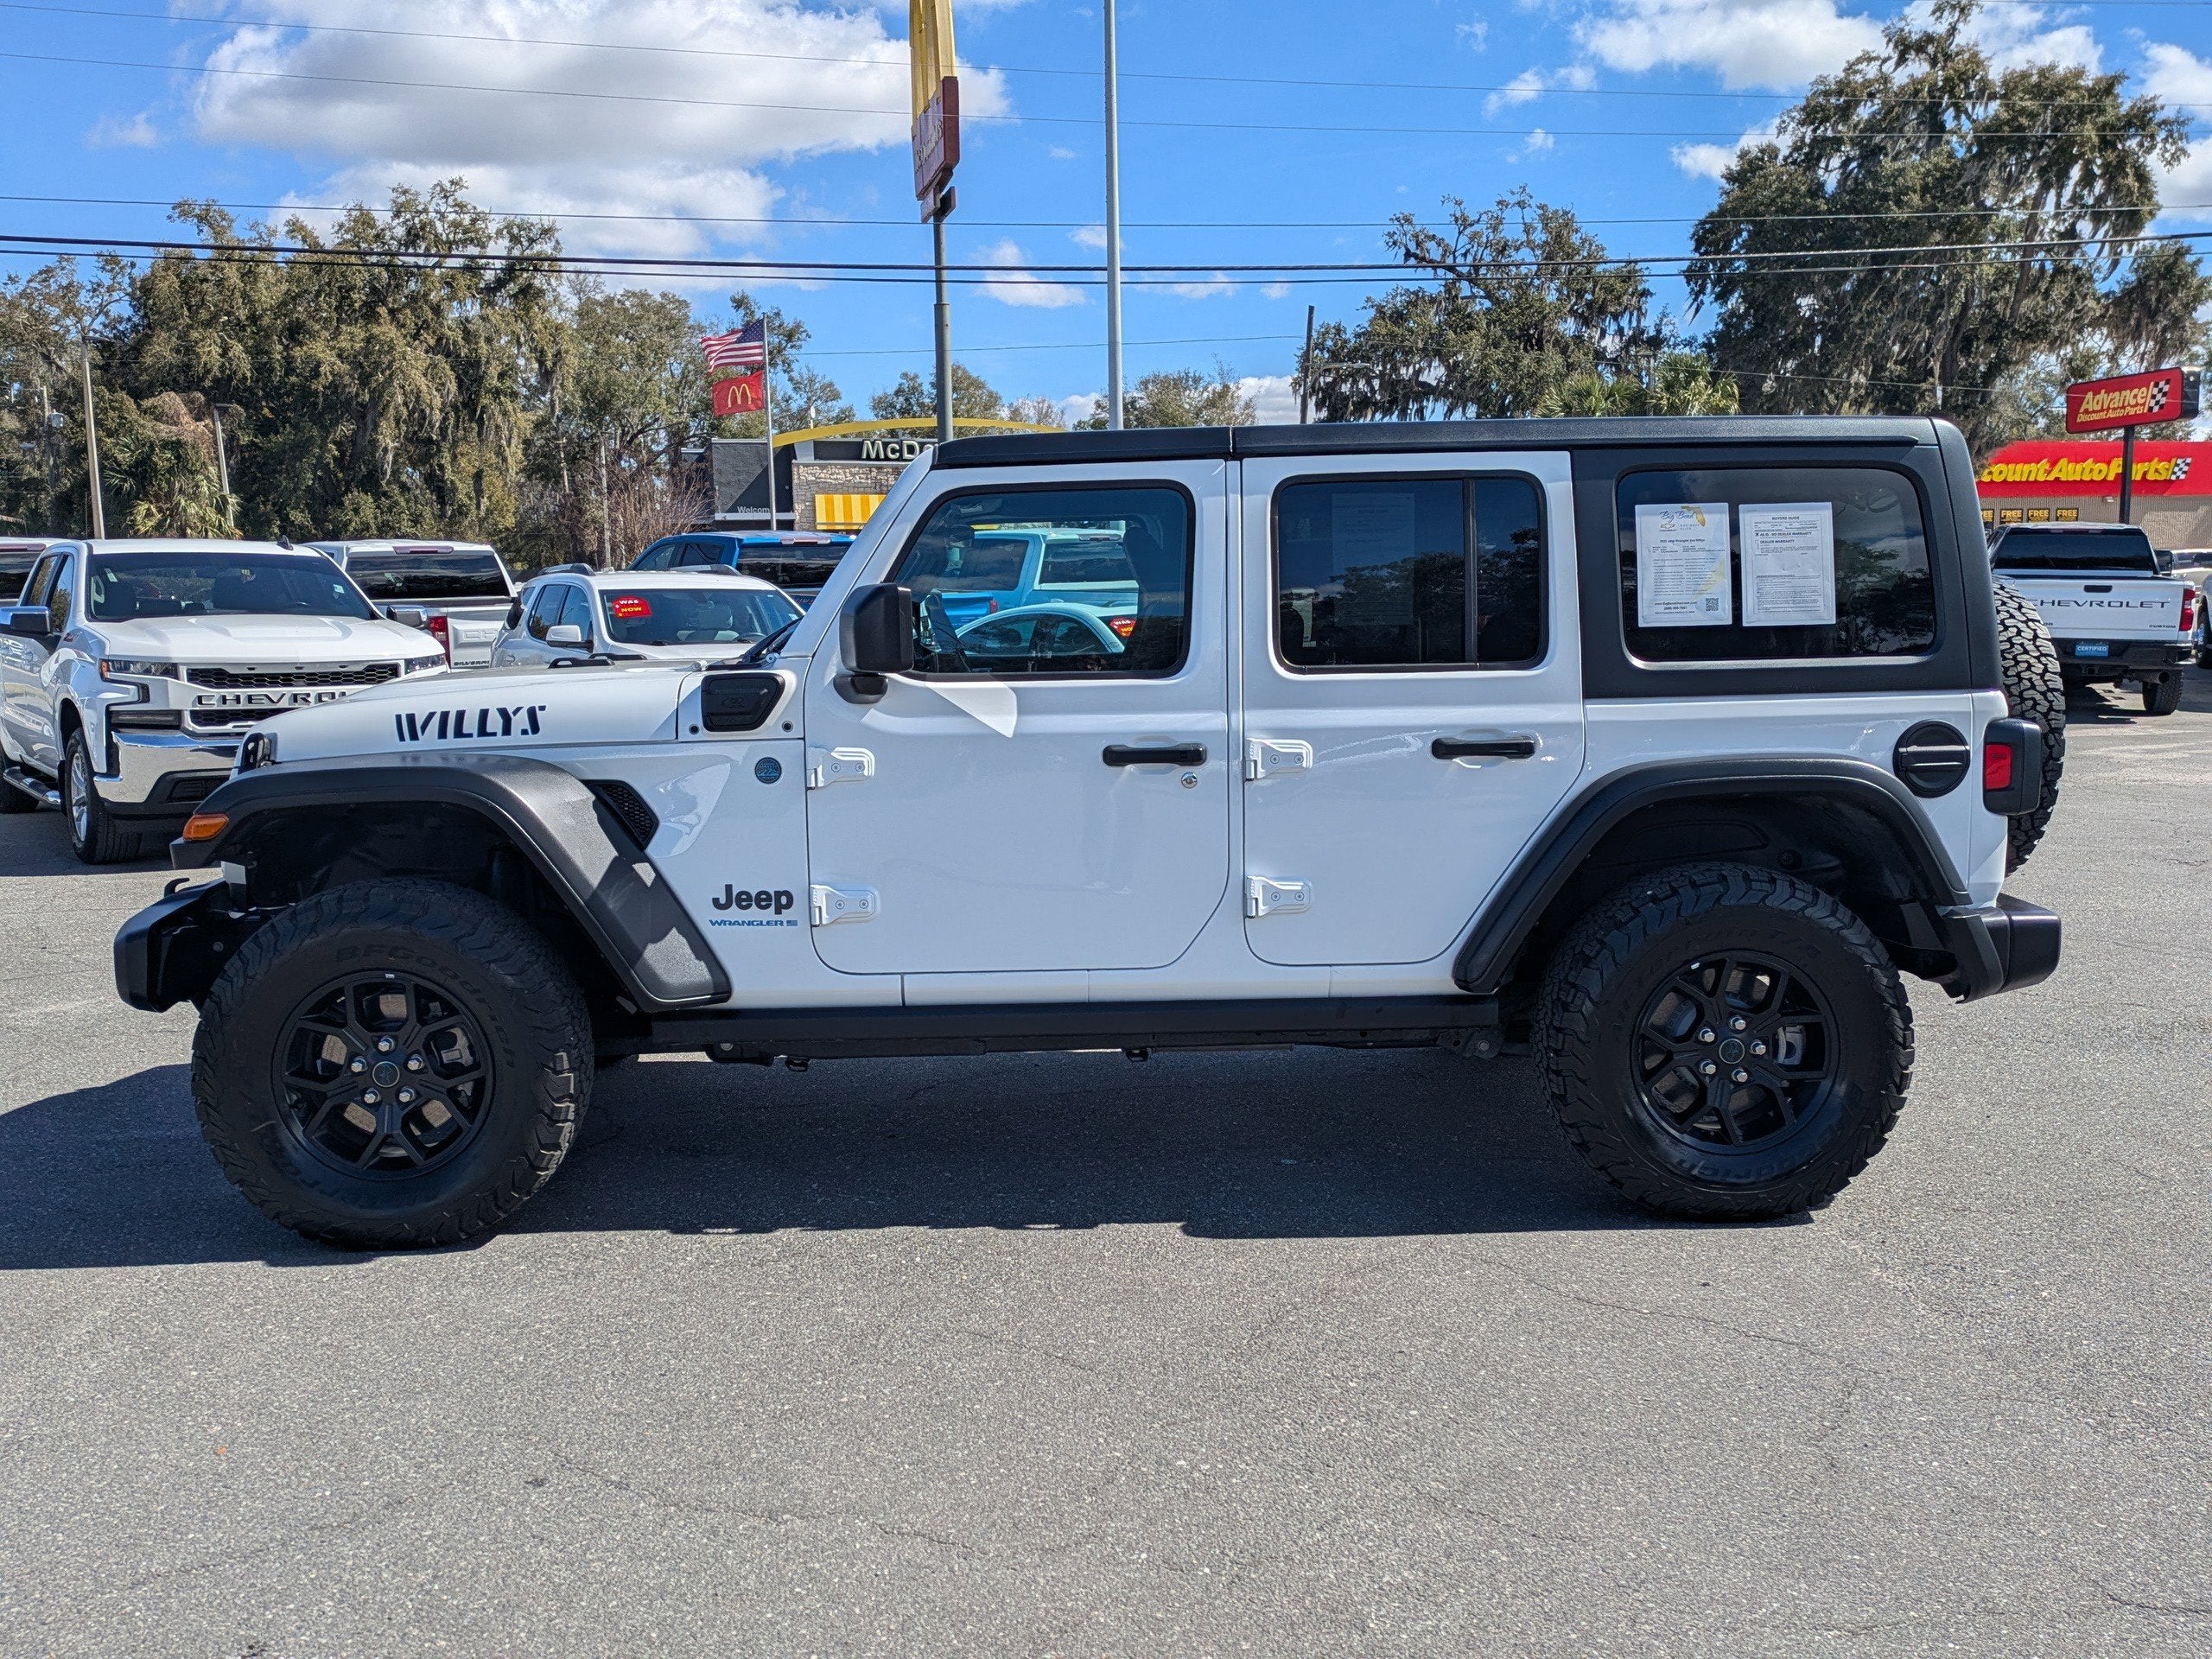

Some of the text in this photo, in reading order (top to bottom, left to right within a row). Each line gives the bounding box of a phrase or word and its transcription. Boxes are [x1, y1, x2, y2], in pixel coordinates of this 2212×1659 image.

[2079, 386, 2148, 413] Advance
[2076, 405, 2144, 423] Discount Auto Parts
[2046, 458, 2110, 481] Auto
[2105, 458, 2170, 481] Prts
[1659, 511, 1676, 523] Big
[2001, 510, 2022, 518] FREE
[2028, 509, 2050, 518] FREE
[2056, 509, 2078, 518] FREE
[395, 705, 546, 742] WILLYS
[712, 884, 794, 915] Jeep
